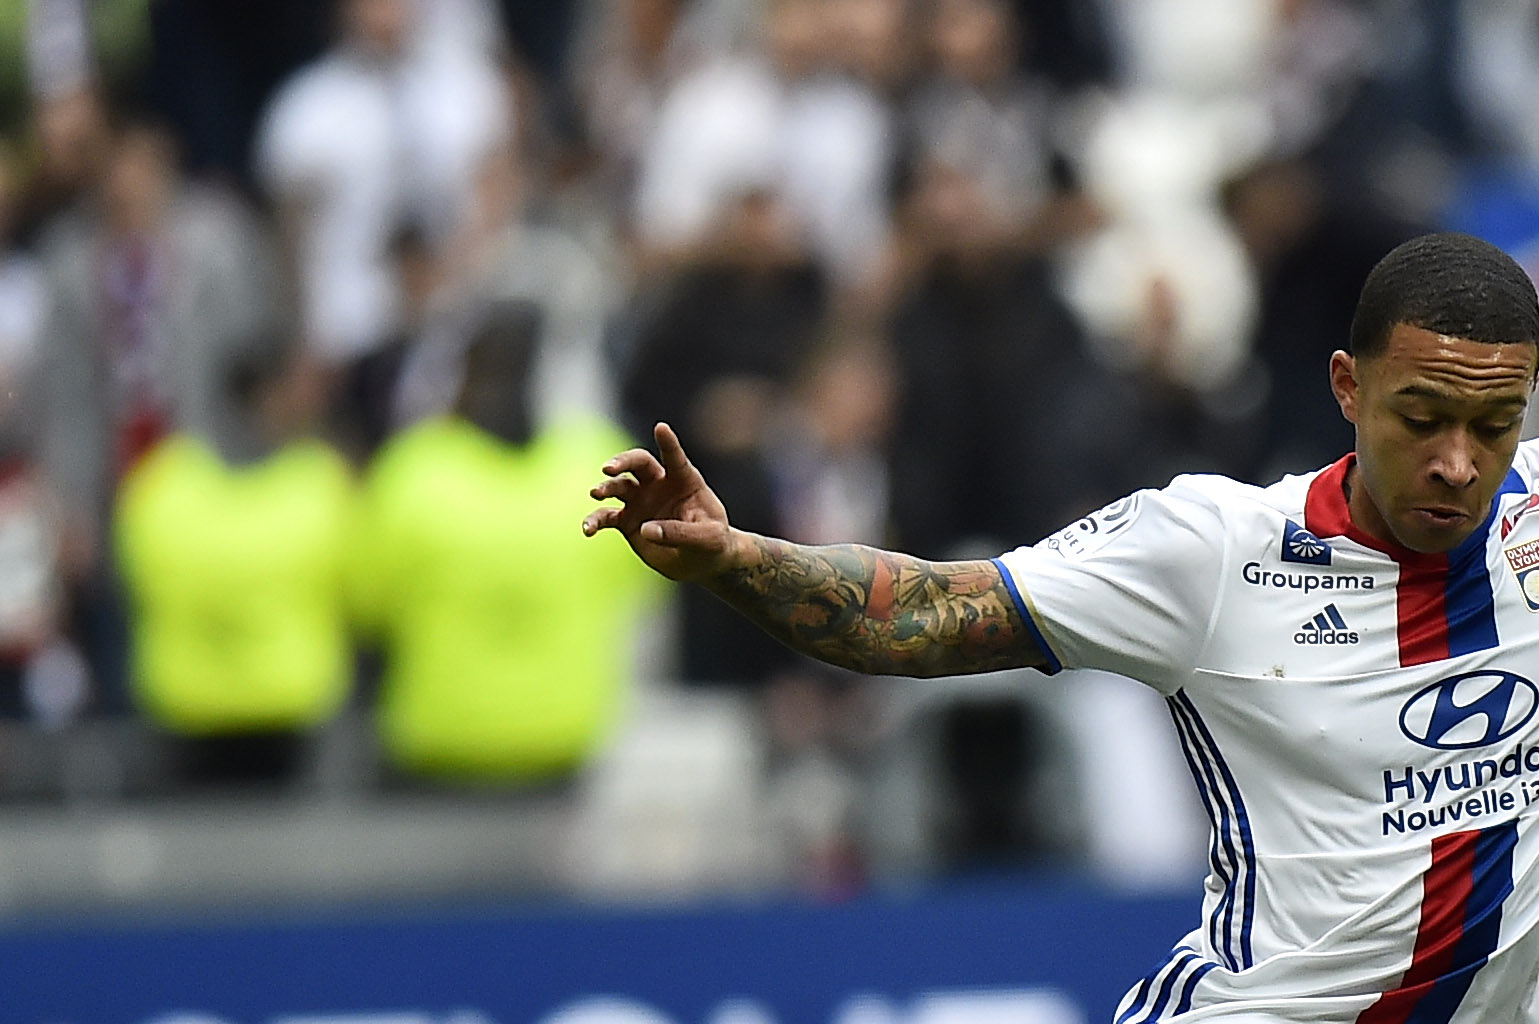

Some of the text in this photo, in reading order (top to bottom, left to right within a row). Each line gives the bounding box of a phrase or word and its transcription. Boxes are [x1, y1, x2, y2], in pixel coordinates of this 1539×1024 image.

[1242, 561, 1375, 595] Groupama
[1293, 629, 1359, 645] adidas
[1382, 789, 1516, 836] Nouvelle
